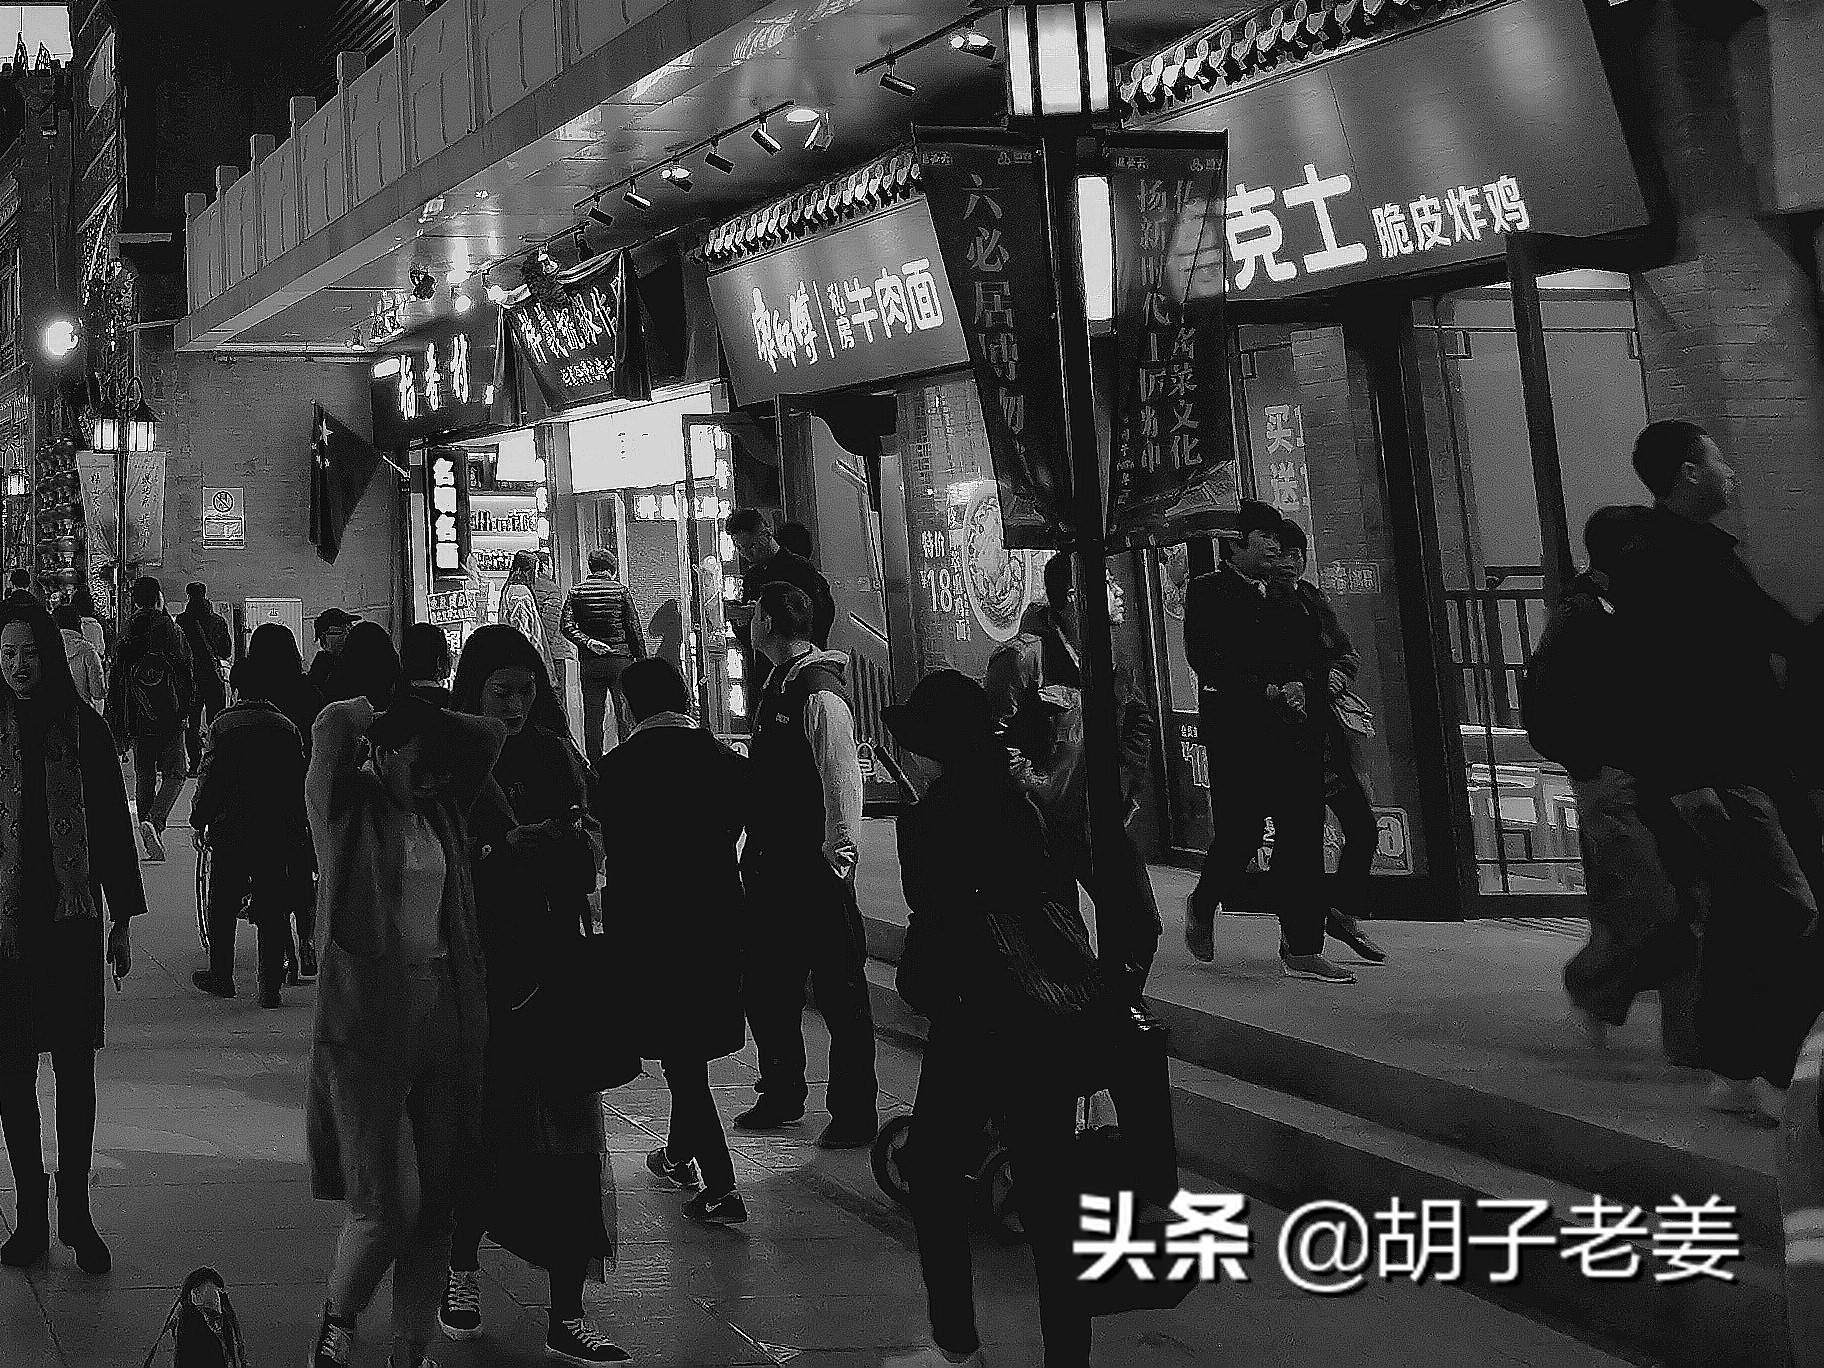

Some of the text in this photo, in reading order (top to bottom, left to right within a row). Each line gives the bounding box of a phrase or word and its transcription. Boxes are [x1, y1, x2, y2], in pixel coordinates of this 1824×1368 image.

[1371, 174, 1531, 260] 脆皮炸鸡
[751, 280, 819, 374] 康师傅
[843, 257, 944, 344] 牛肉面
